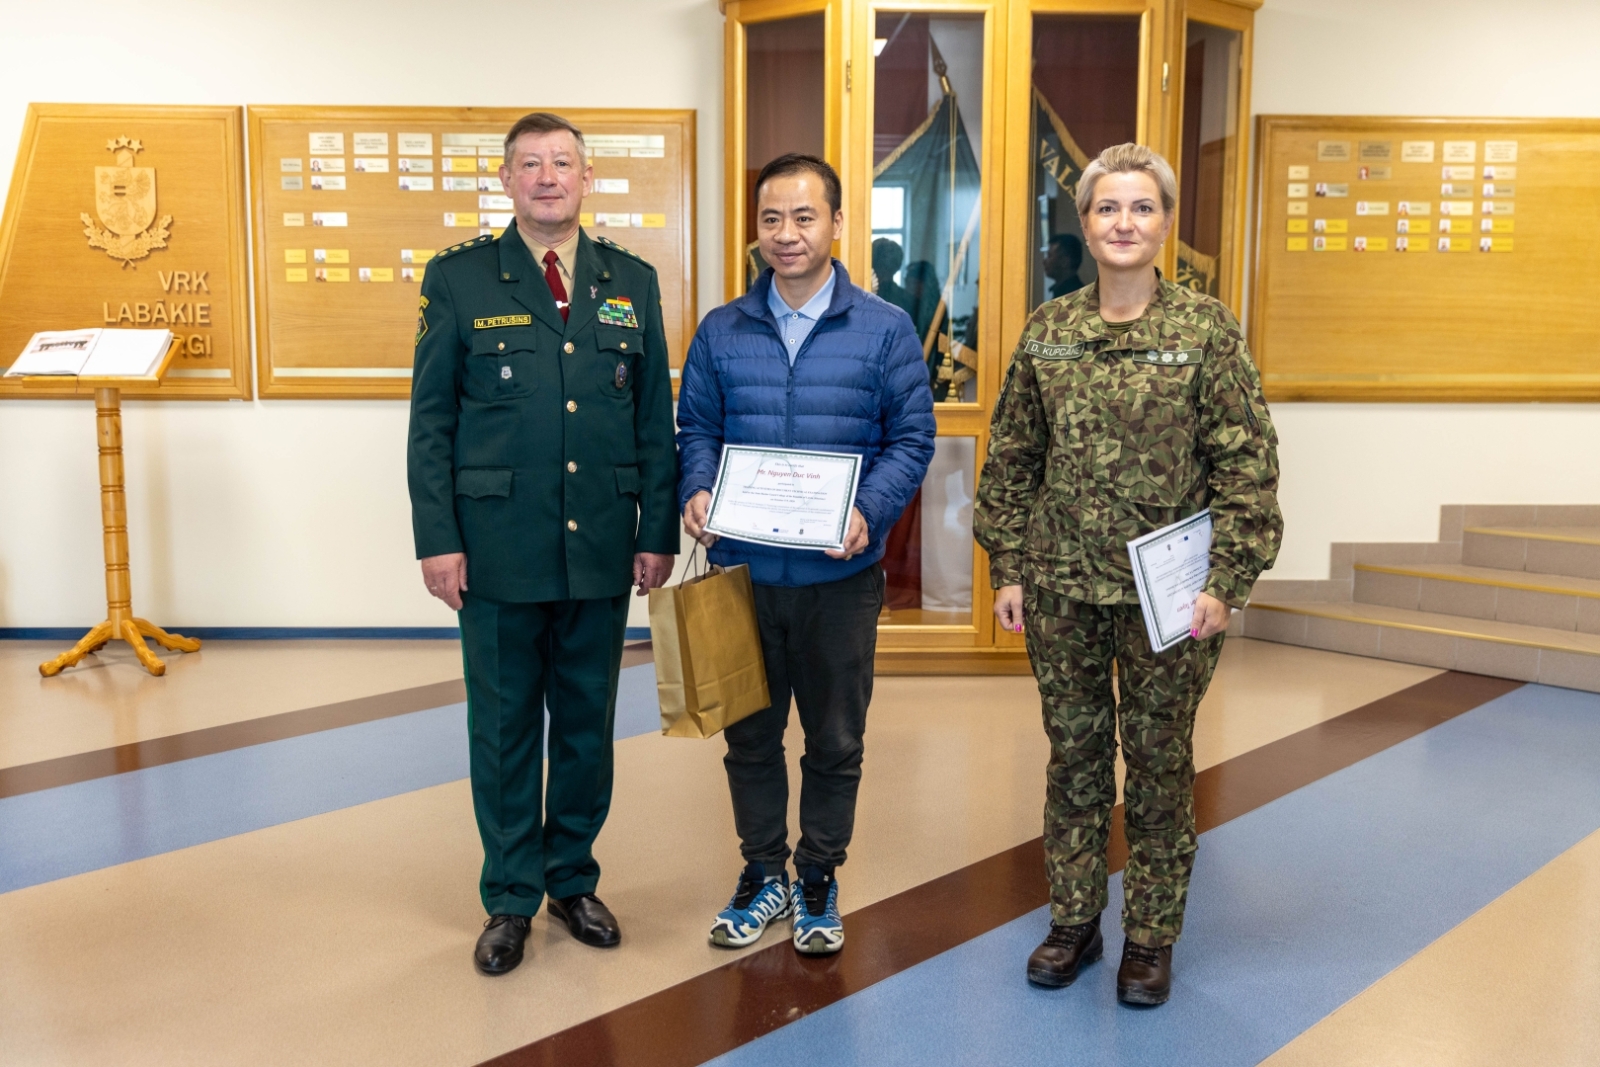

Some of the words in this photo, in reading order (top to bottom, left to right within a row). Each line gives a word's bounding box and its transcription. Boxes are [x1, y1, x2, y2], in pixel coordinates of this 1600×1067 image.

[158, 270, 209, 292] VRK
[103, 299, 211, 324] LABĀKIE
[1030, 343, 1039, 353] D.
[767, 469, 792, 478] Nguyen
[792, 471, 805, 479] Duc
[806, 472, 821, 480] Vinh
